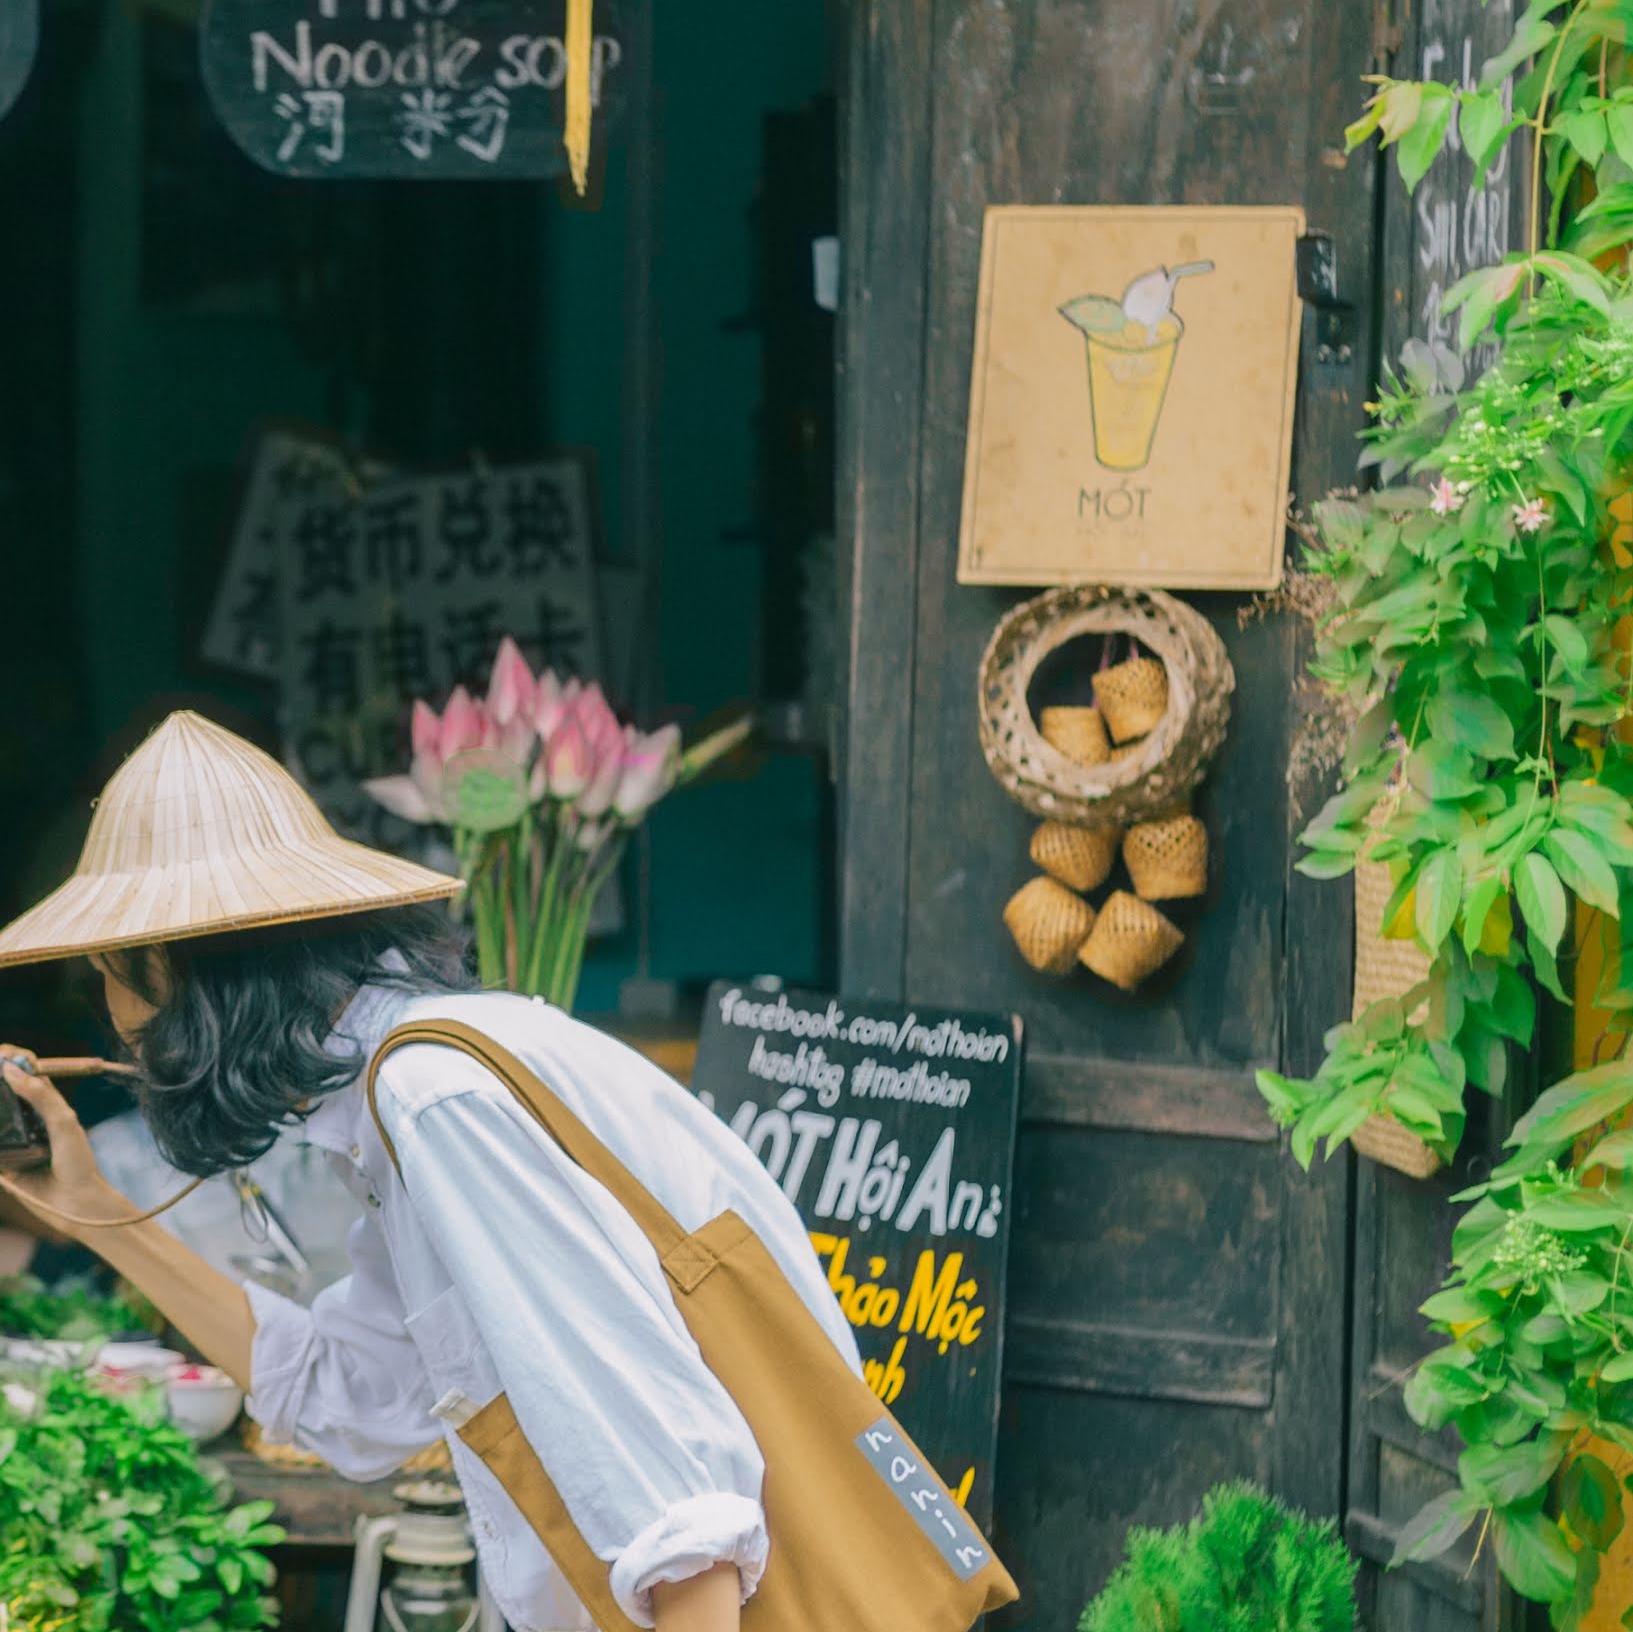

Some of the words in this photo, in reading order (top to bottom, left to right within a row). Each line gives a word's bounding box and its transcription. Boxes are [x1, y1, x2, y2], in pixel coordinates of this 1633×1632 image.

[250, 19, 482, 92] Noodle
[495, 34, 622, 109] sop
[748, 1034, 846, 1109] hashtag
